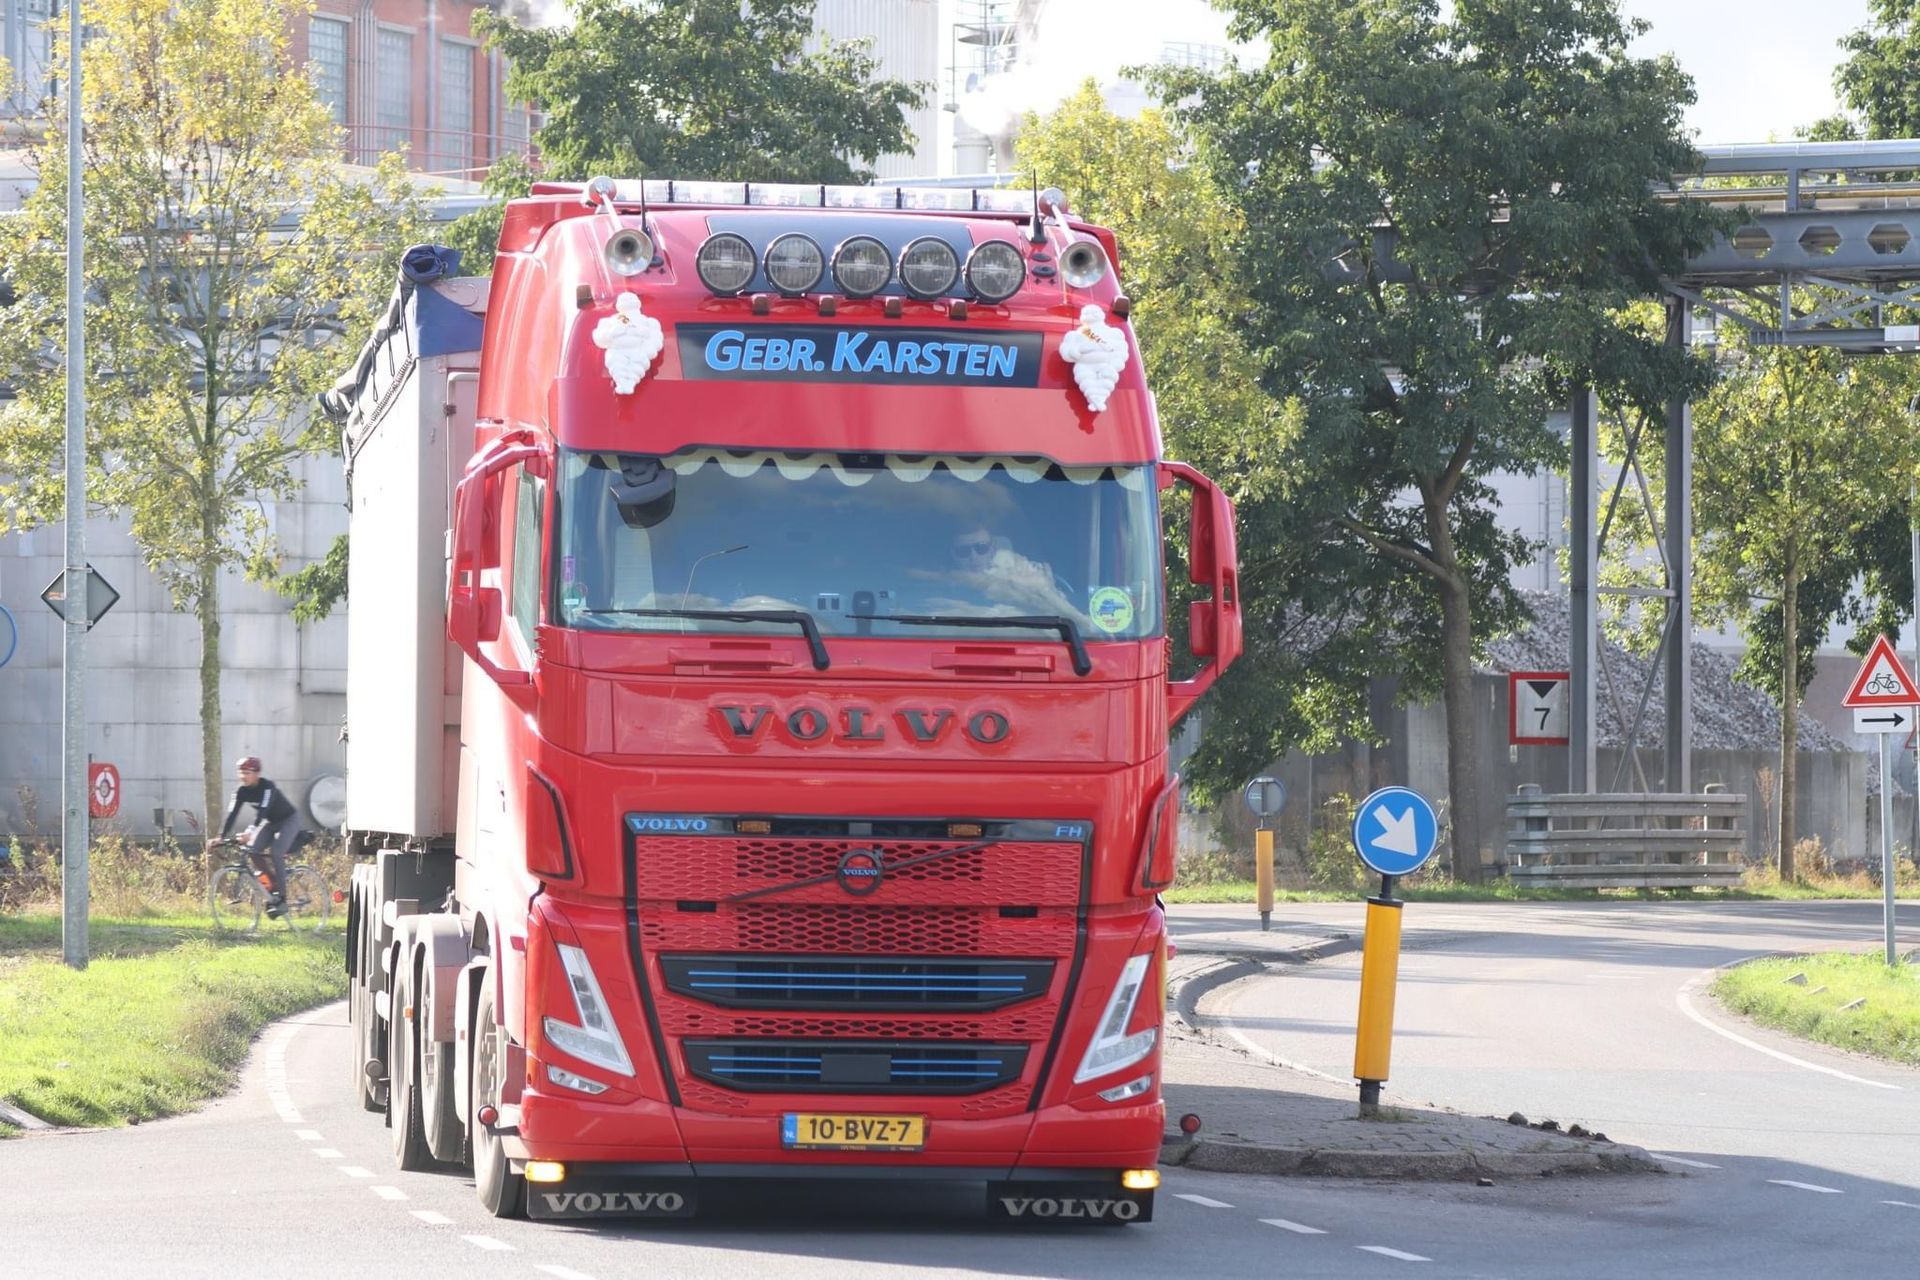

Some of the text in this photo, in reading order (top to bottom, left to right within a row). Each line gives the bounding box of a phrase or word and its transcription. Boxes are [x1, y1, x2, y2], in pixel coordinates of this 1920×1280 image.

[704, 329, 1018, 378] GEBR. KARSTEN
[715, 705, 1010, 744] VOLVO
[1533, 707, 1551, 731] 7
[630, 817, 708, 831] VOLVO
[1055, 825, 1083, 837] FH
[842, 868, 878, 877] VOLVO
[785, 1118, 911, 1142] NL 10-BVZ-7
[541, 1191, 684, 1213] VOLVO
[1000, 1197, 1140, 1220] VOLVO
